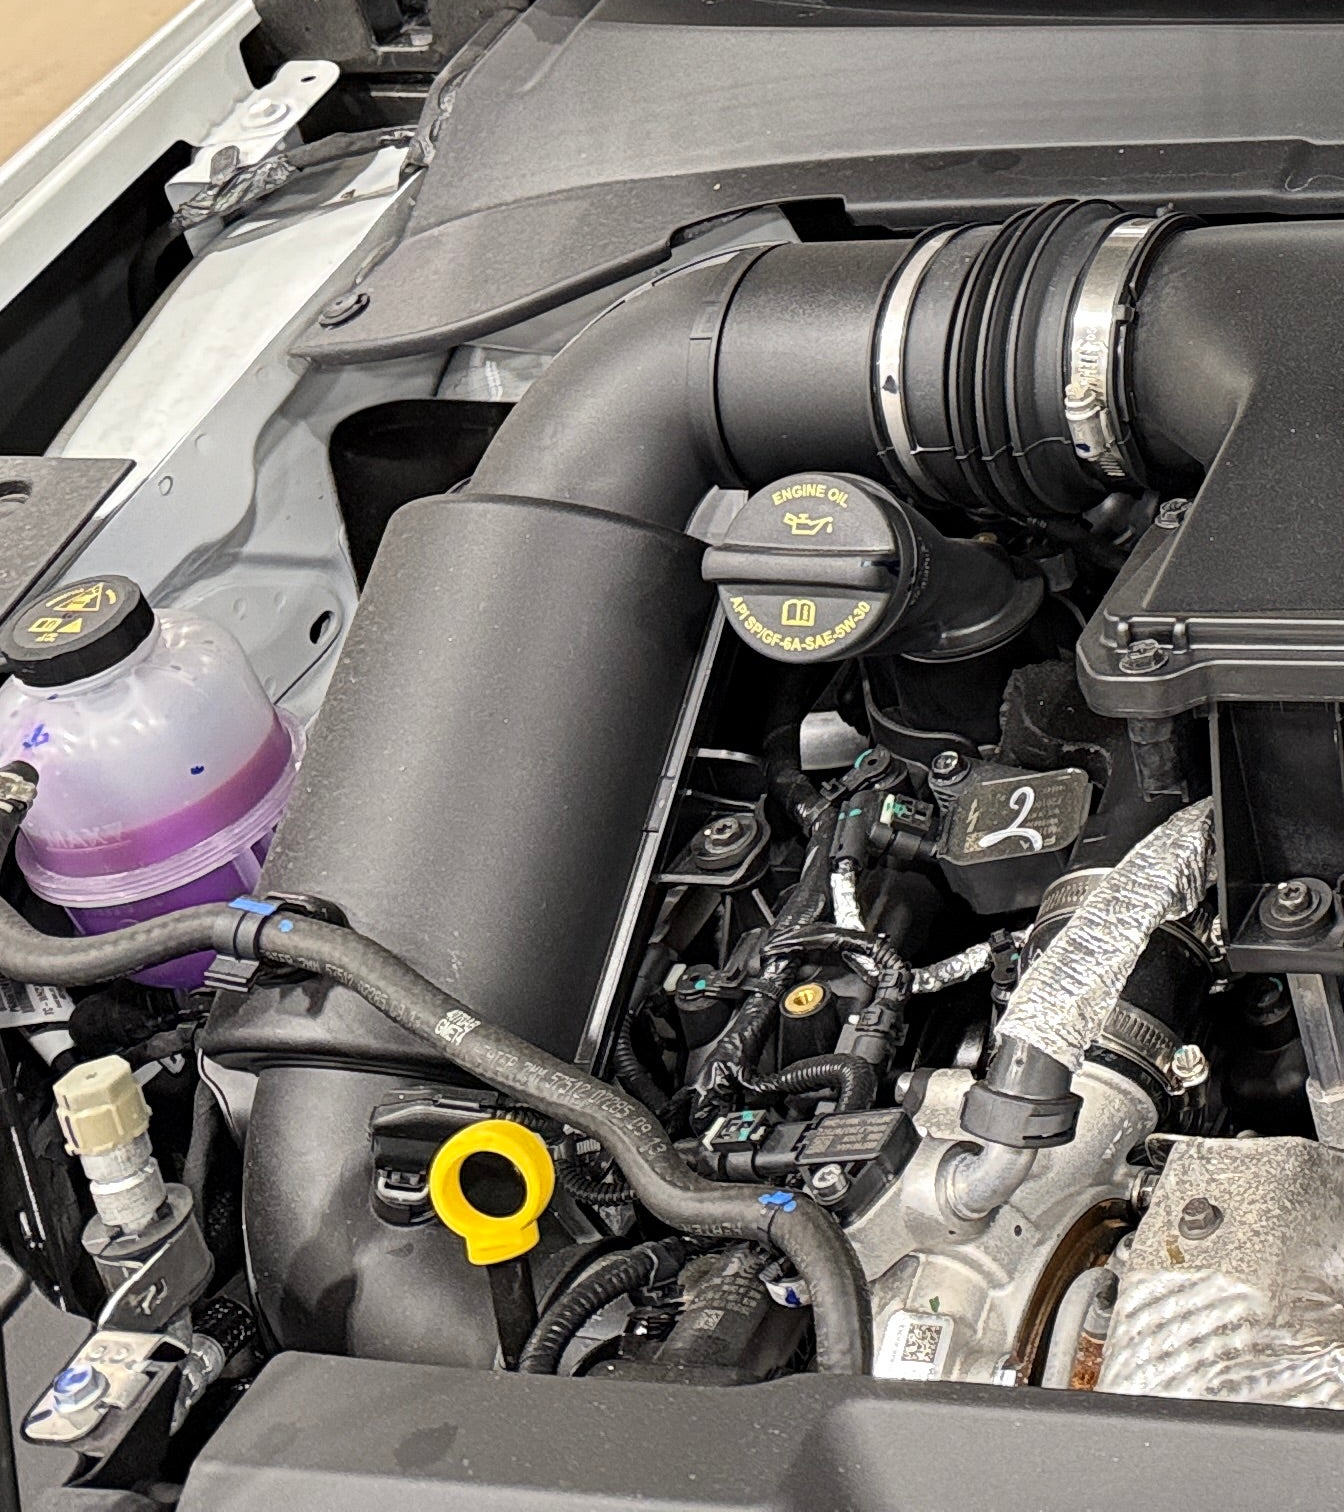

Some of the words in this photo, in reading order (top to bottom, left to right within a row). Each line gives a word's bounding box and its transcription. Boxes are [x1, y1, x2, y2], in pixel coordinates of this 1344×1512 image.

[772, 484, 826, 506] ENGINE
[827, 488, 849, 509] OIL
[729, 595, 747, 621] API
[977, 786, 1043, 852] 2
